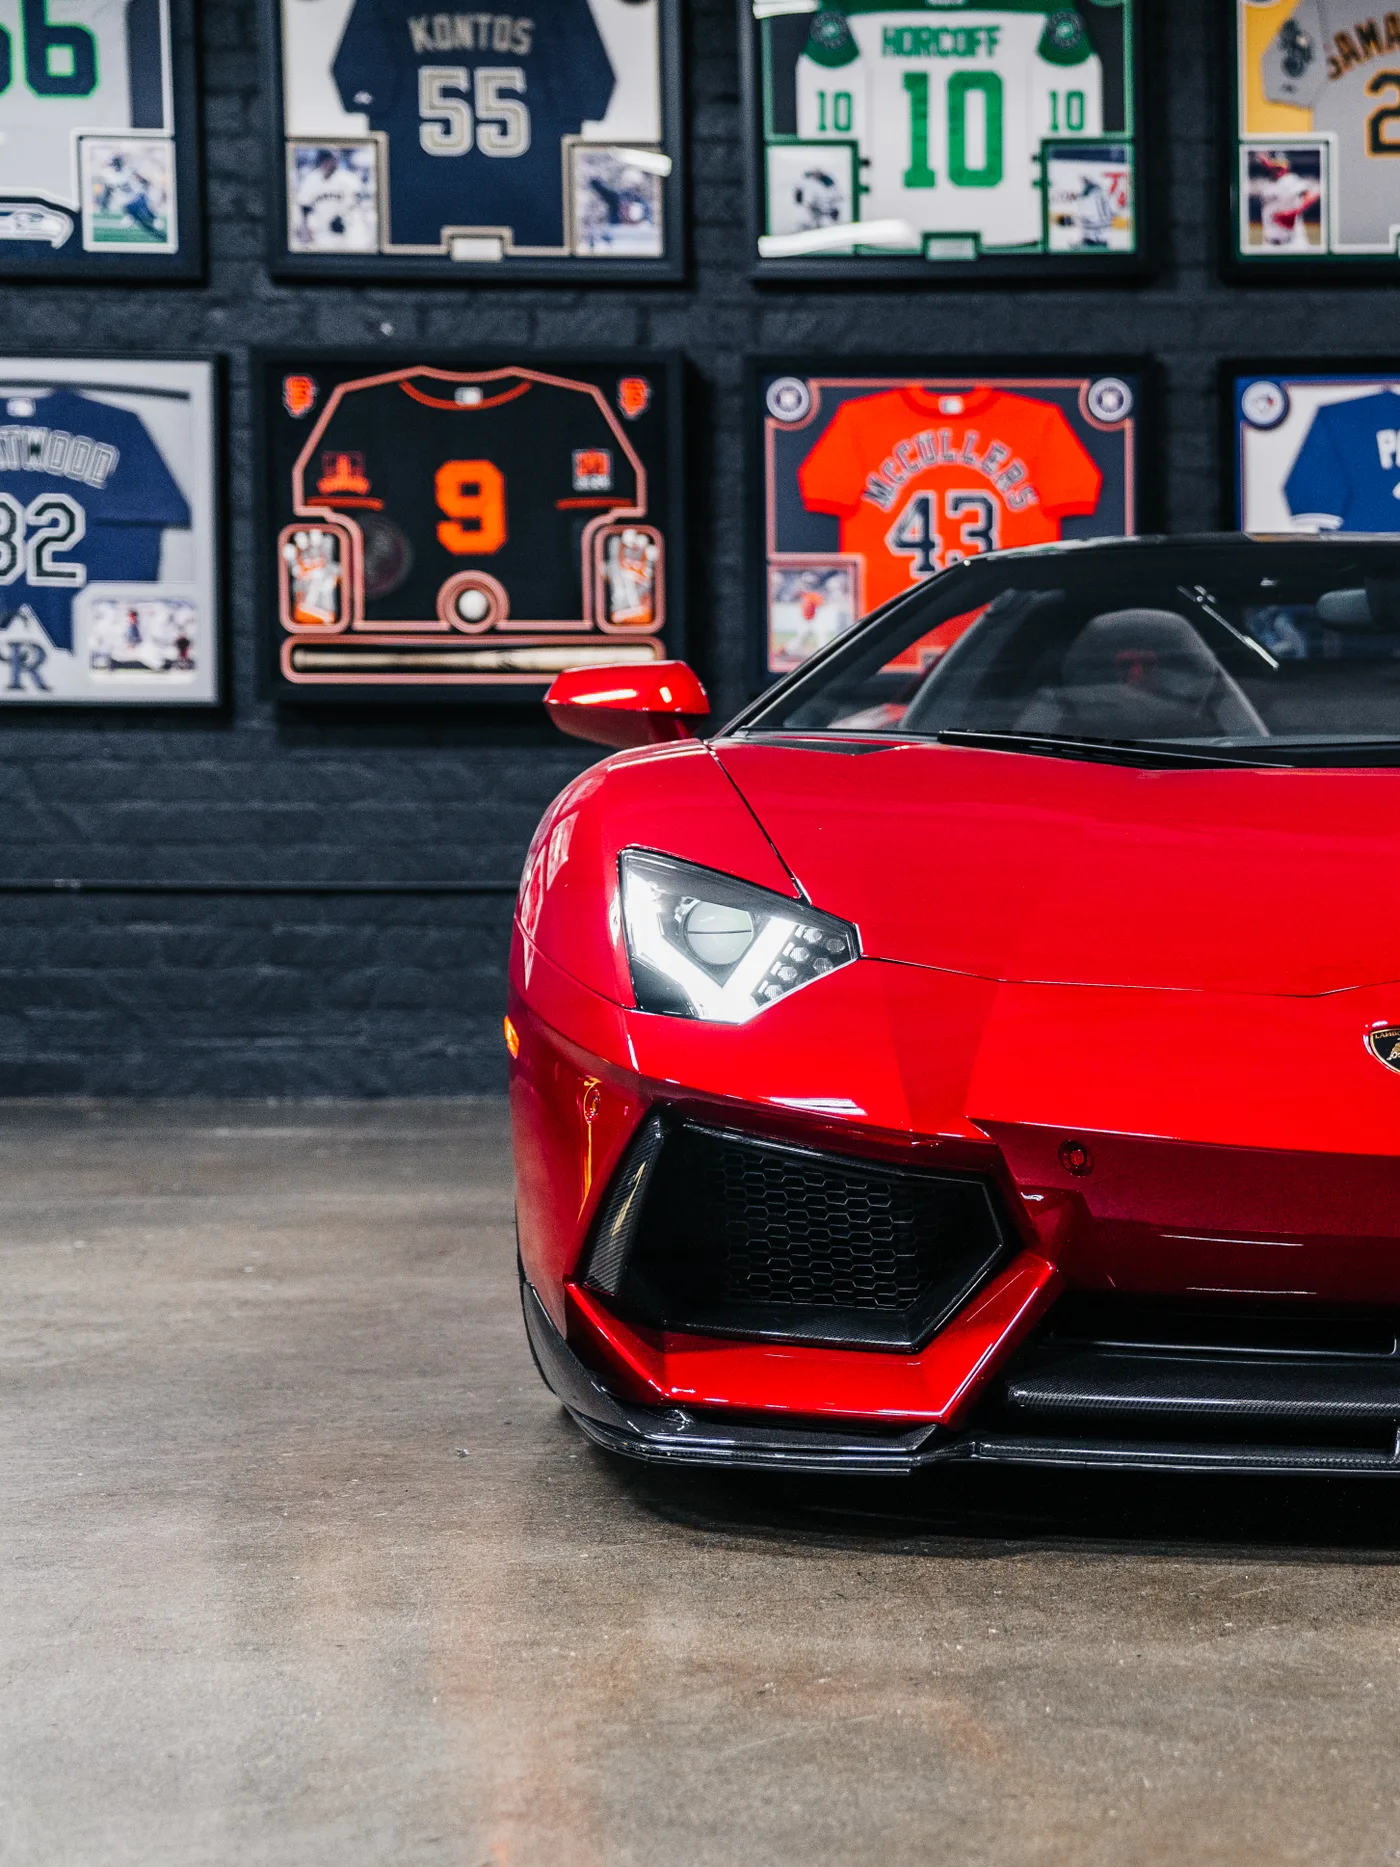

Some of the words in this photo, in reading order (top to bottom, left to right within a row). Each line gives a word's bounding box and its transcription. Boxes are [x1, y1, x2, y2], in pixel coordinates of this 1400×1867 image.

[0, 0, 99, 98] 6
[407, 12, 535, 55] KONTOS
[881, 25, 1002, 57] HORCOFF
[418, 65, 531, 158] 55
[817, 90, 852, 132] 10
[903, 70, 1003, 188] 10
[1049, 90, 1085, 132] 10
[434, 459, 507, 556] 9
[884, 489, 1001, 580] 43
